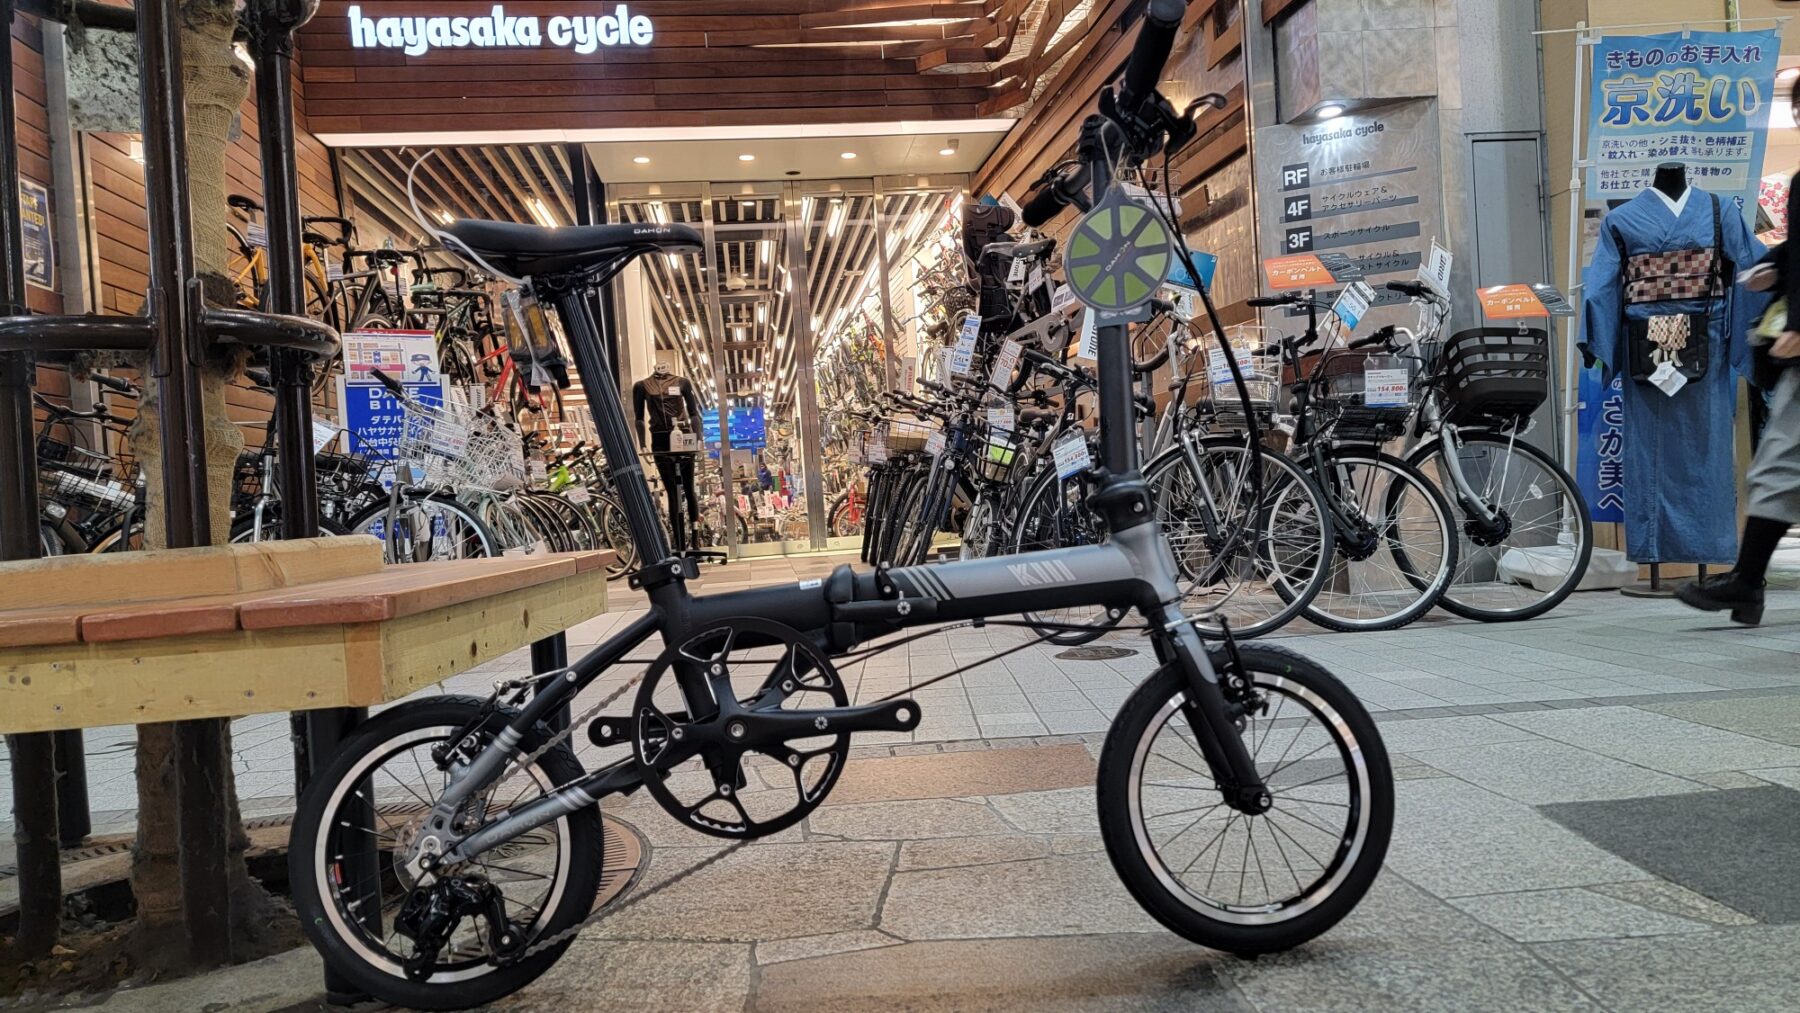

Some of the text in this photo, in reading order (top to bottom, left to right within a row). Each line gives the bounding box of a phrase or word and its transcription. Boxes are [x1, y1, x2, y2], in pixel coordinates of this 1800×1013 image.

[348, 4, 653, 56] hayasaka cycle
[1606, 44, 1762, 69] きもののお手入れ
[1601, 71, 1758, 126] 京洗い
[1302, 121, 1384, 146] hayasaka cycle
[1284, 168, 1308, 186] RF
[1287, 199, 1308, 216] 4F
[1288, 231, 1310, 249] 3F
[1105, 240, 1131, 272] DAHON
